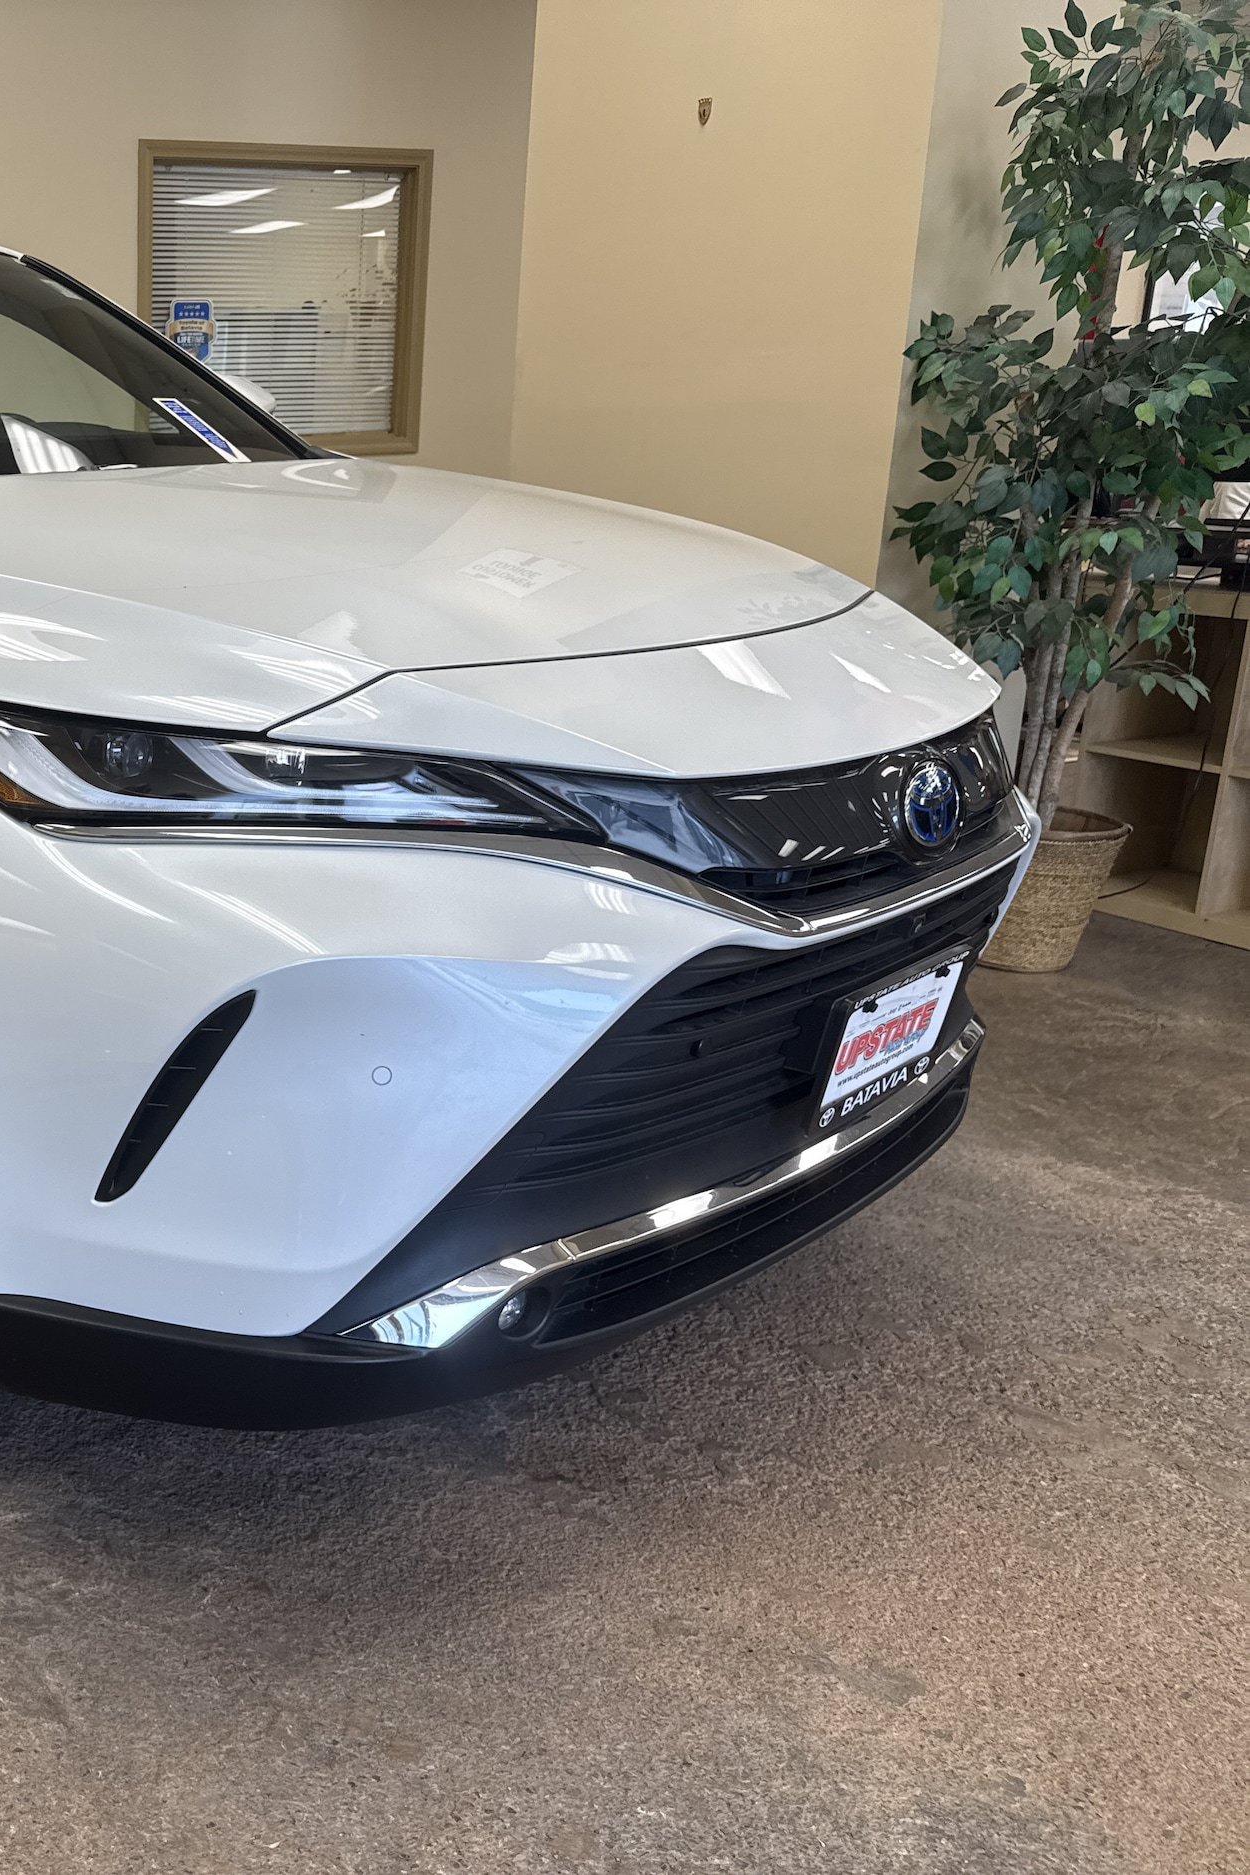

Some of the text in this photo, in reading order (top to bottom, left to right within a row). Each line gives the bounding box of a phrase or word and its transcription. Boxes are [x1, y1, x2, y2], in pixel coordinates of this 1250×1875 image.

[854, 950, 970, 1010] UPSTATE AUTO GROUP
[834, 997, 939, 1076] UPSTATE
[837, 1043, 914, 1088] www.upstateautogroup.com
[841, 1066, 908, 1117] BATAVIA
